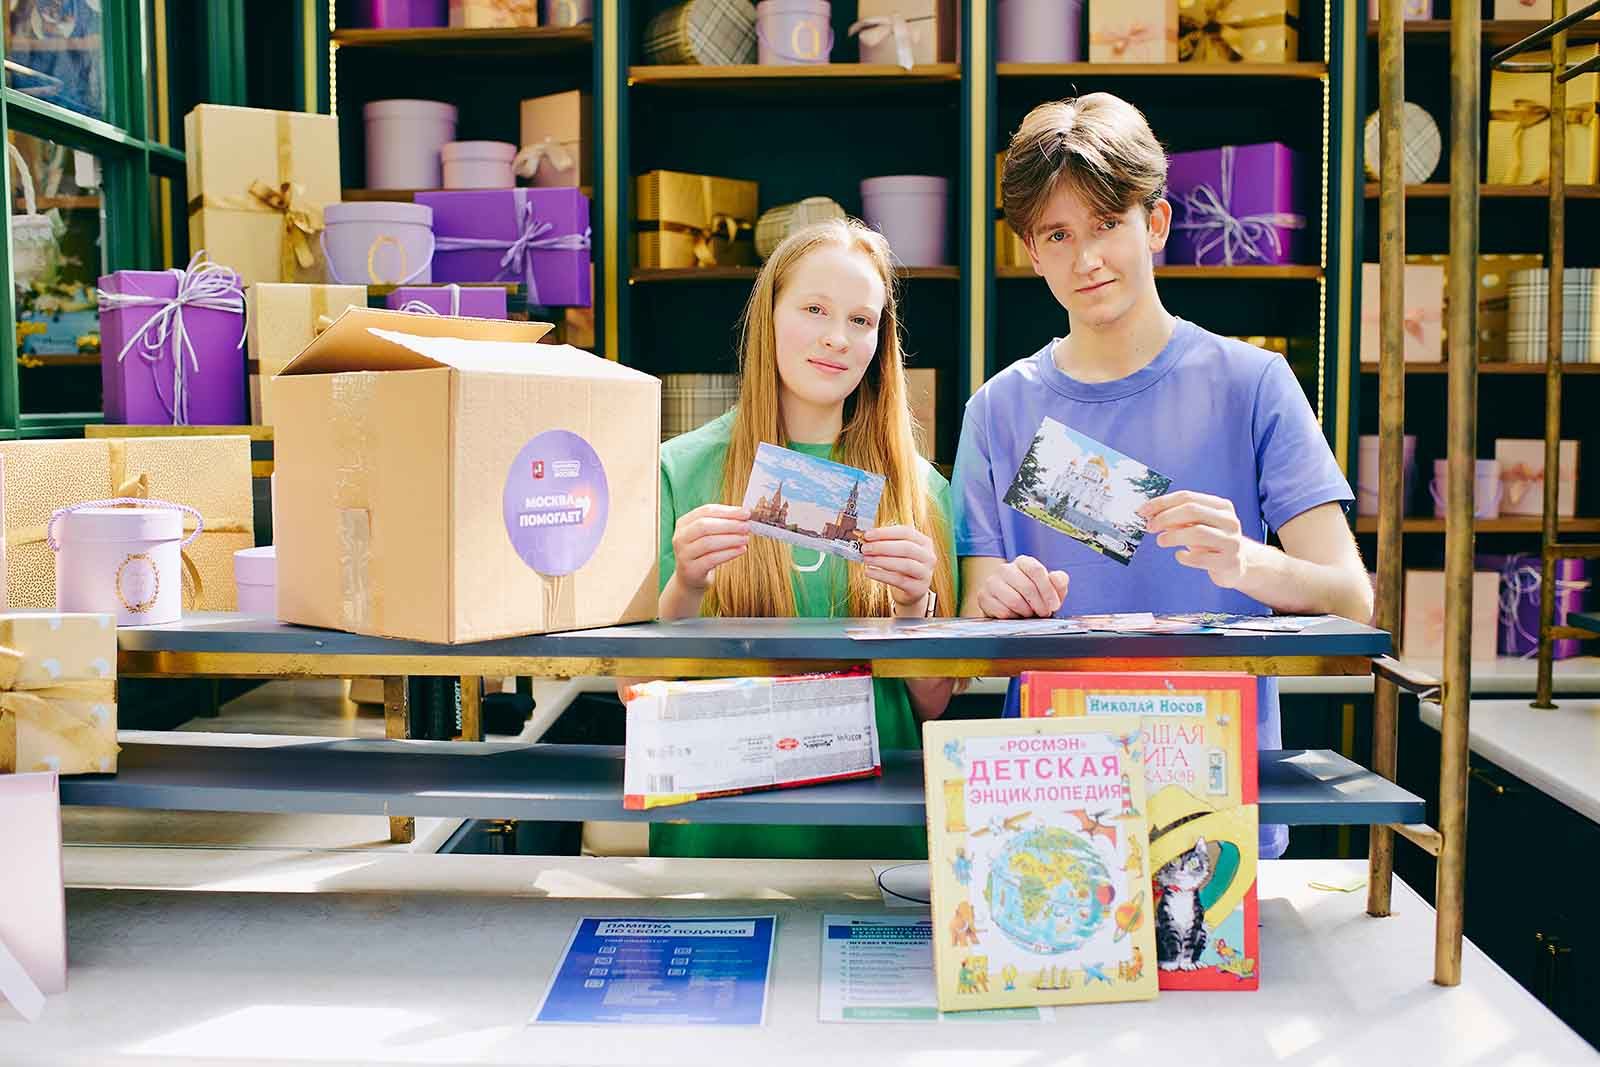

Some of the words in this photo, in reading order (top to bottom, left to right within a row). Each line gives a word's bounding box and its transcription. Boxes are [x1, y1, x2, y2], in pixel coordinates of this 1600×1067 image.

[526, 495, 575, 508] МОСКВА
[519, 511, 582, 527] ПОМОГАЕТ
[967, 755, 1120, 786] ДЕТСКАЯ
[968, 784, 1122, 806] ЭНЦИКЛОПЕДИЯ
